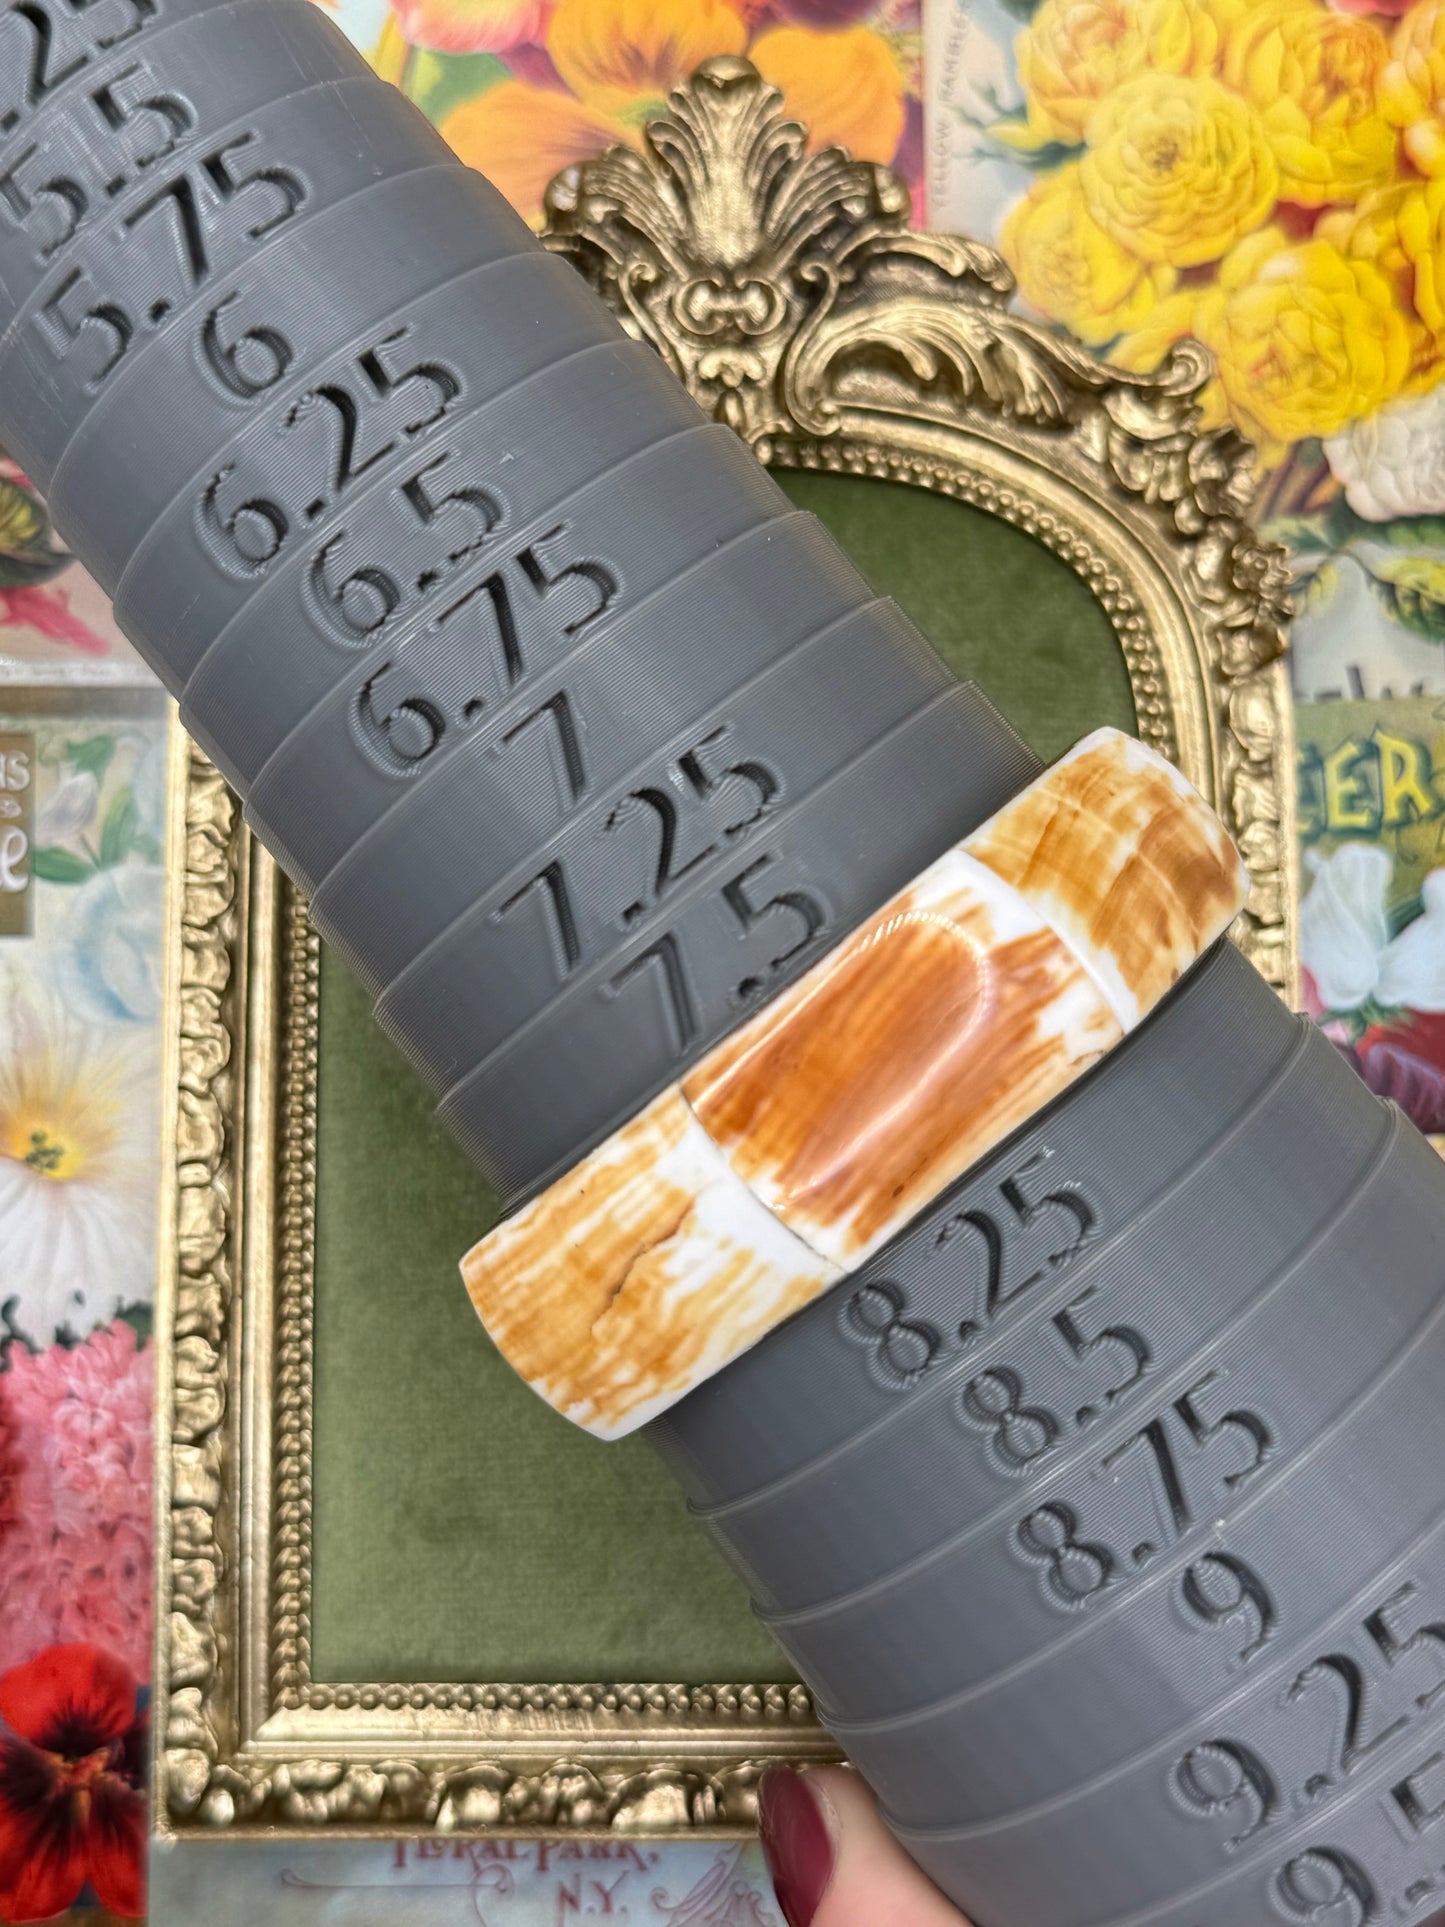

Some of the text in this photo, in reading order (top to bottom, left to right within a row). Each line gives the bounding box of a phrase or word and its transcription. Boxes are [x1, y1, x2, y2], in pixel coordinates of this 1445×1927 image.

[0, 60, 199, 266] 5.5
[35, 130, 309, 394] 5.75
[930, 121, 951, 209] YELLOW
[195, 290, 294, 407] 6
[196, 323, 466, 580] 6.25
[303, 449, 511, 649] 6.5
[350, 521, 626, 777] 6.75
[490, 725, 784, 978] 7.25
[495, 690, 592, 811] 7
[602, 849, 832, 1056] 7.5
[837, 1147, 1102, 1389] 8.25
[955, 1286, 1157, 1478] 8.5
[1008, 1368, 1278, 1612] 8.75
[1173, 1551, 1279, 1674] 9
[1167, 1579, 1445, 1853] 9.25
[556, 1869, 630, 1922] N.Y.
